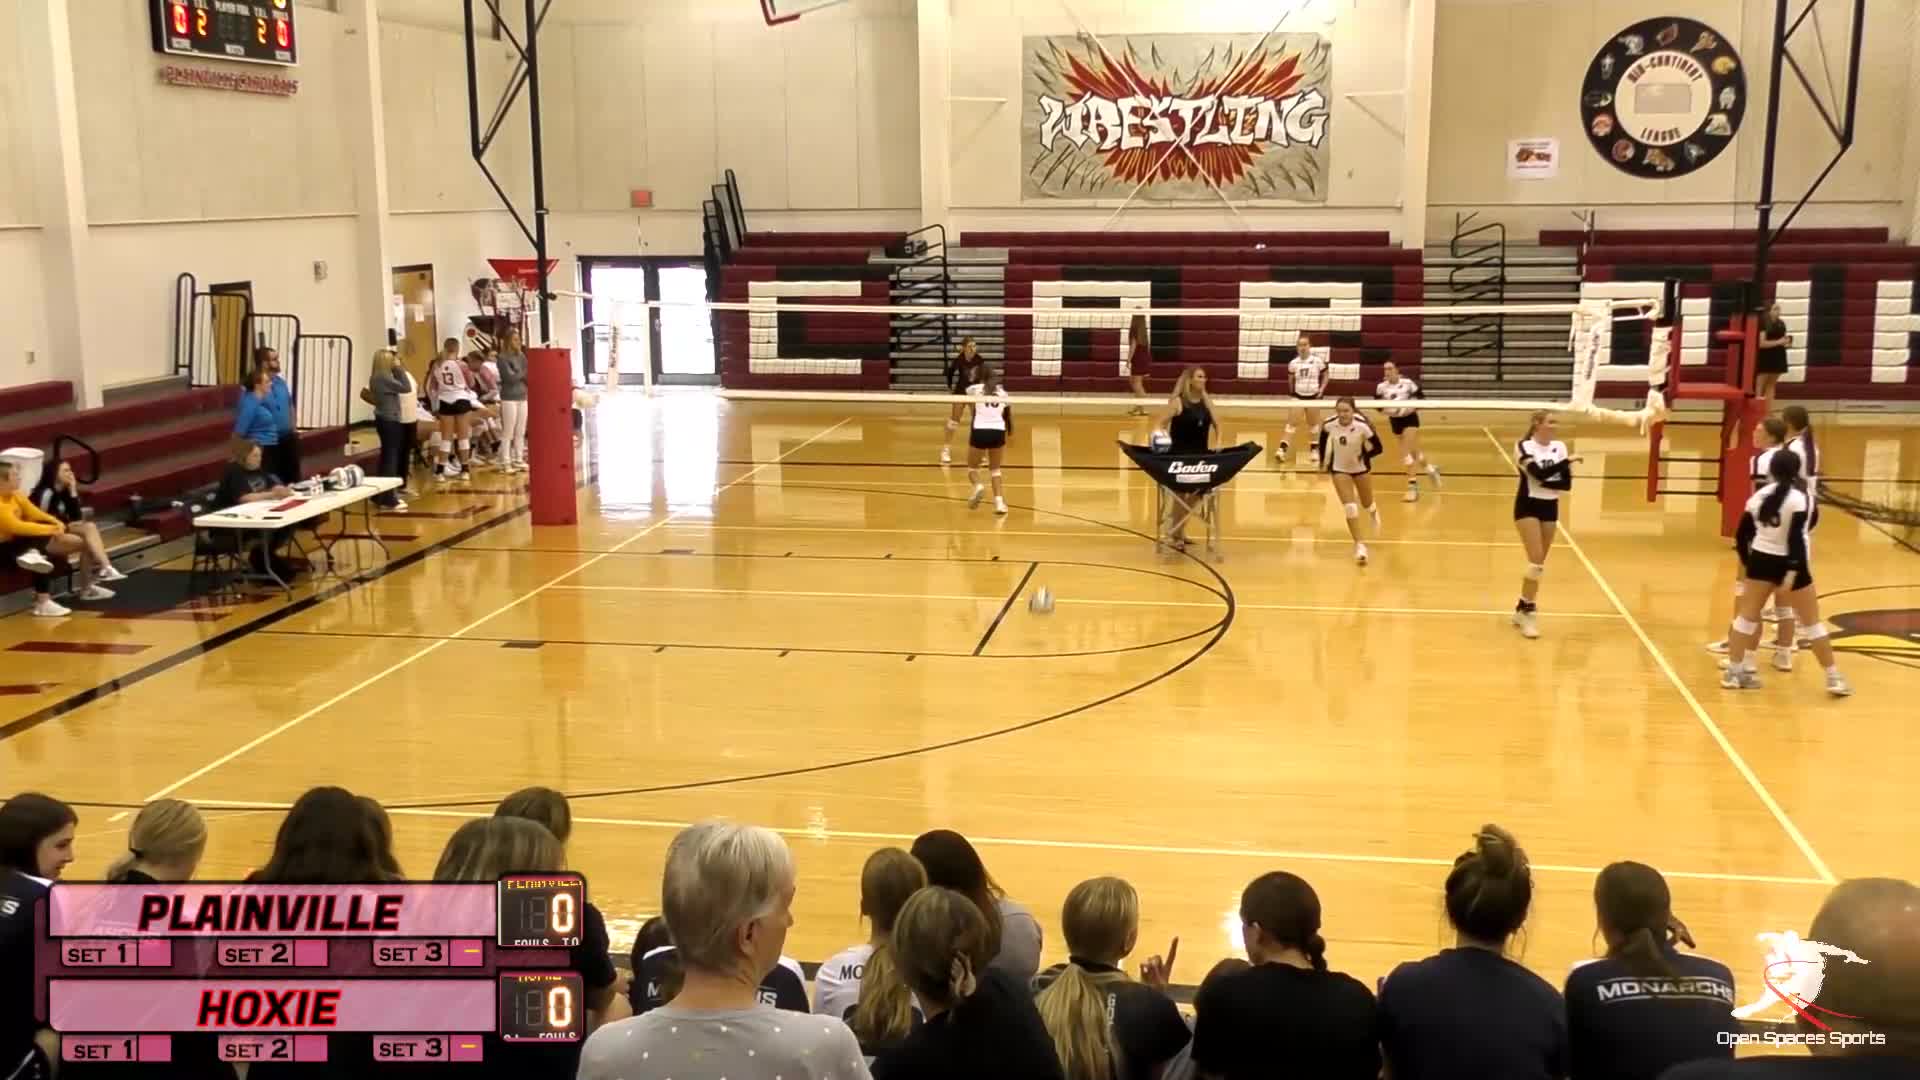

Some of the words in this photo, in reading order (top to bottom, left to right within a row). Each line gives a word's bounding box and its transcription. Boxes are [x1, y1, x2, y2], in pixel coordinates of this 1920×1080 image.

[1039, 88, 1330, 150] WRESTLING
[1640, 127, 1681, 142] LEAGUE
[1168, 460, 1219, 474] Baden
[1597, 981, 1734, 1003] MONARCHS
